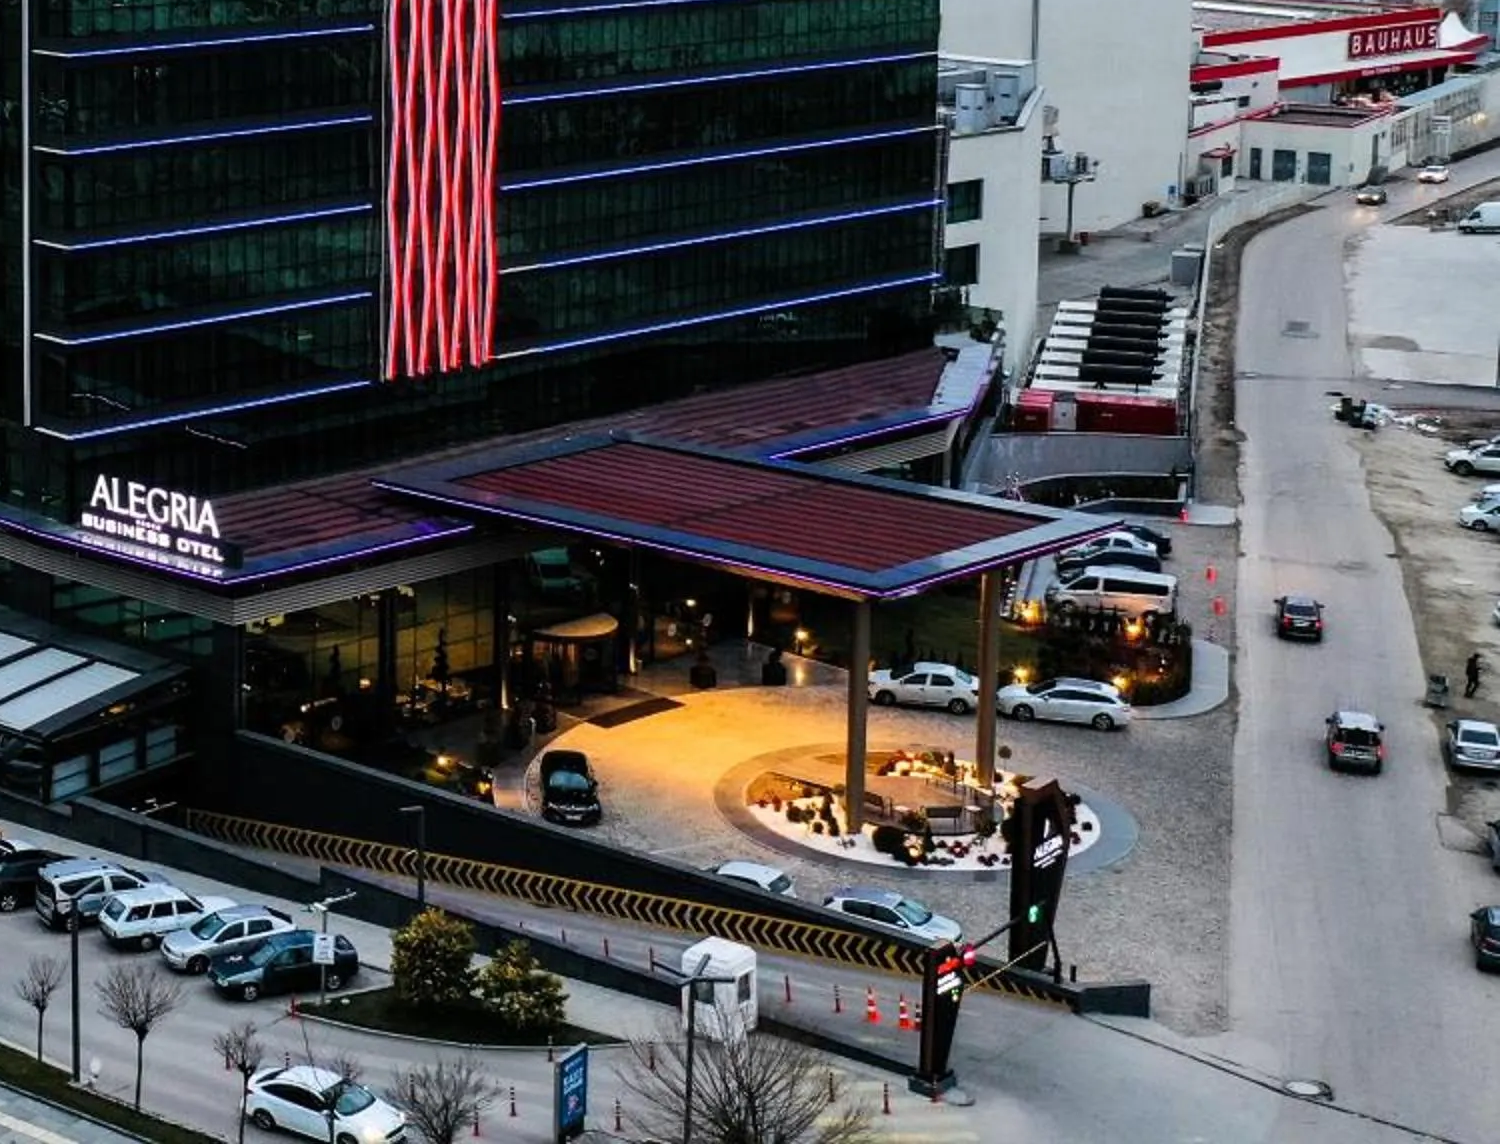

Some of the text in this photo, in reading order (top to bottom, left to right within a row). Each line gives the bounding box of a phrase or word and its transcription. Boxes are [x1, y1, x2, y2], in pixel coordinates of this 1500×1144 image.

[1351, 25, 1437, 55] BAUHAUS
[89, 473, 221, 540] ALEGRIA
[81, 512, 225, 562] BUSINESS OTEL
